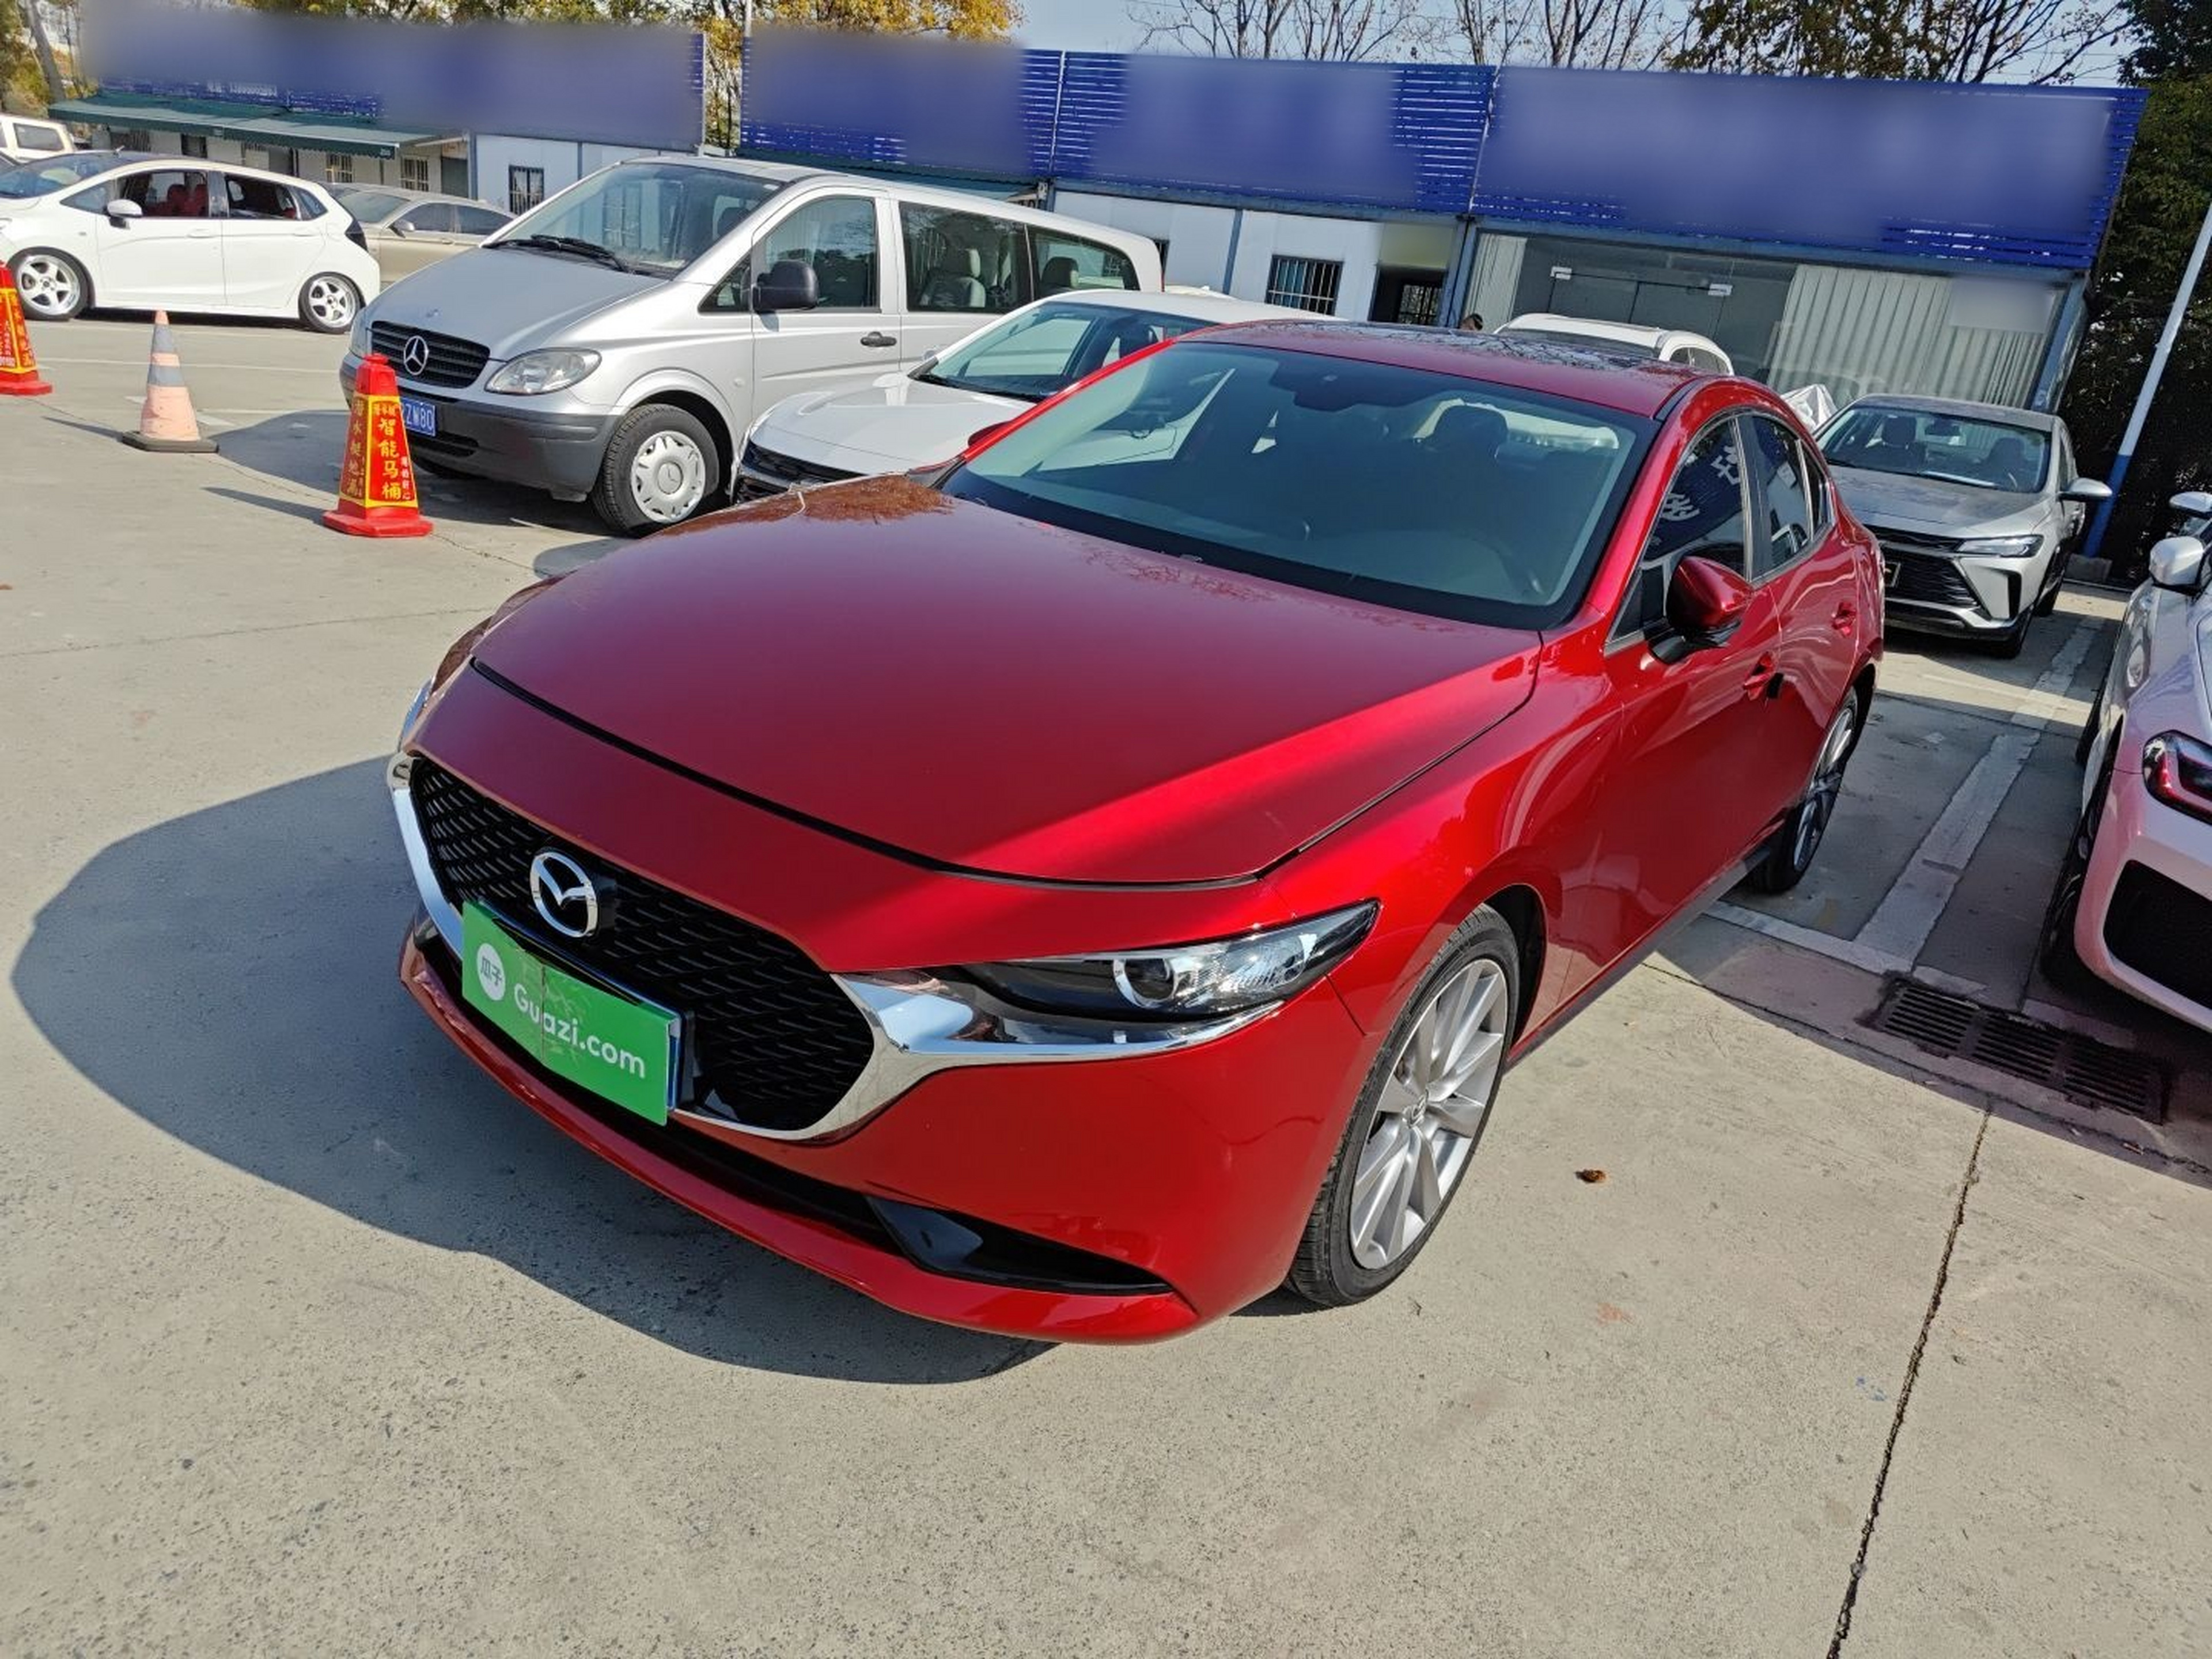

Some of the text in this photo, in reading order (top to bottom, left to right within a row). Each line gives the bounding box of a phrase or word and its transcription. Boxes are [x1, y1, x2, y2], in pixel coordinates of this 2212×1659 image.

[377, 417, 402, 500] 智能马桶
[481, 956, 503, 986] 瓜子
[514, 983, 646, 1079] Guazi.com
